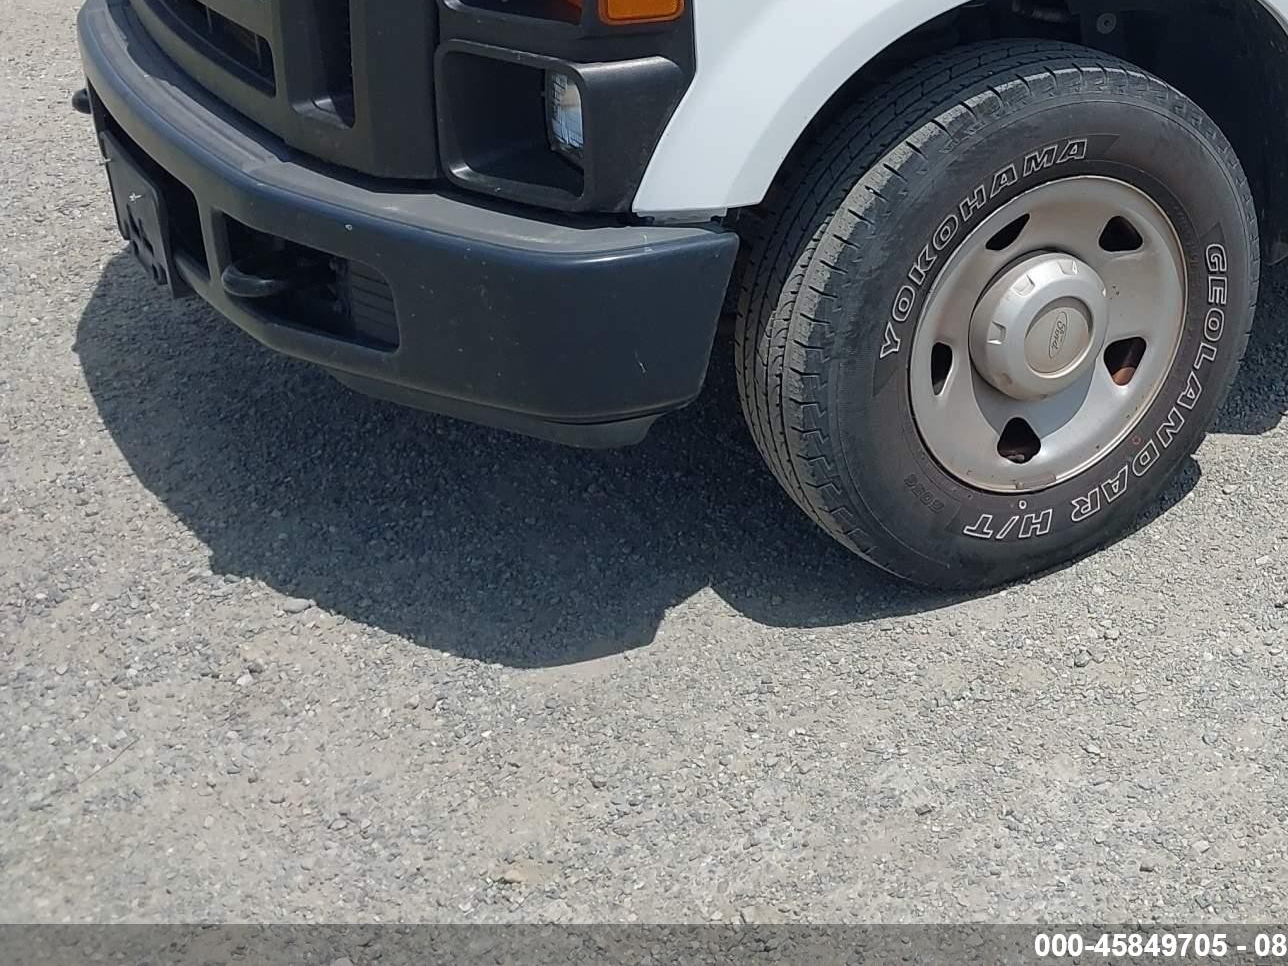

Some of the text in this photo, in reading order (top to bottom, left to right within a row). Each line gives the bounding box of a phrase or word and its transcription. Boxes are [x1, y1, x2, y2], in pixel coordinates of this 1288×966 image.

[879, 138, 1089, 360] YOKOHAMA
[963, 243, 1228, 540] GEOLANDAR H/T
